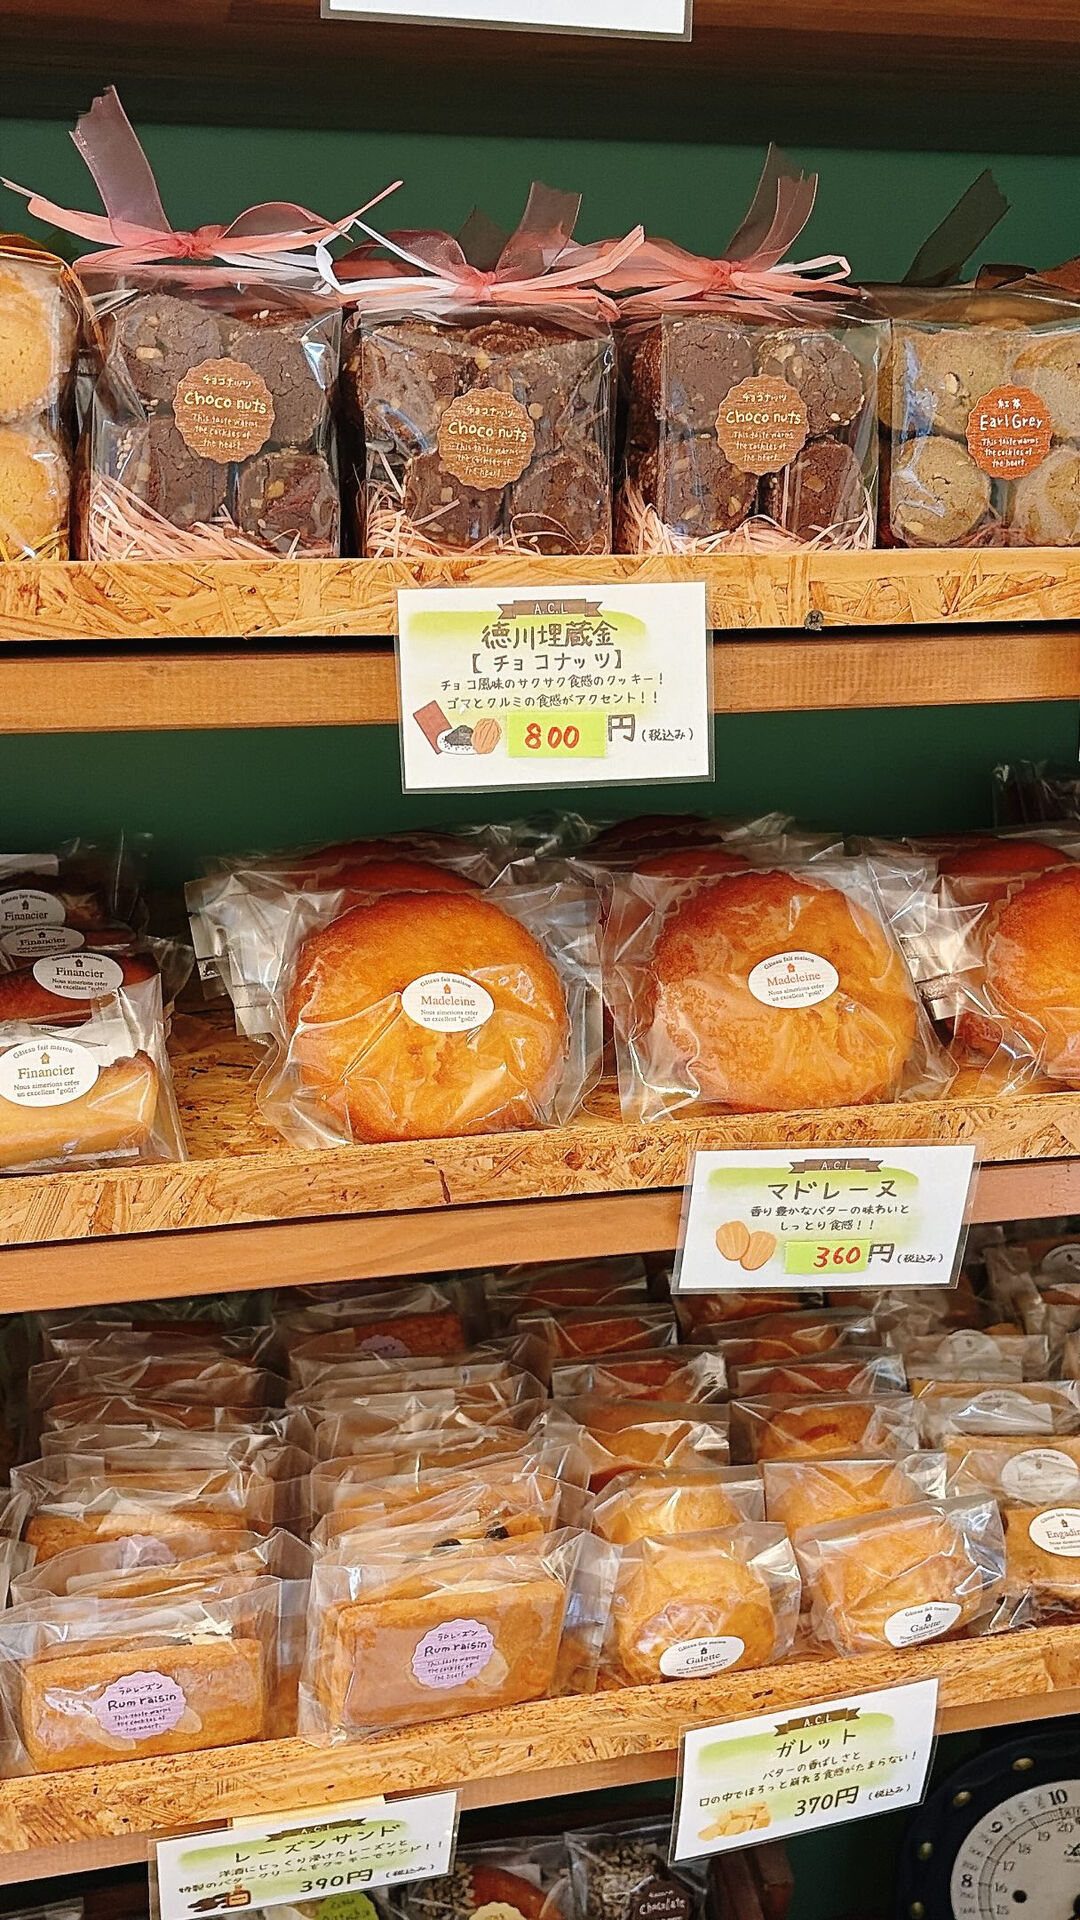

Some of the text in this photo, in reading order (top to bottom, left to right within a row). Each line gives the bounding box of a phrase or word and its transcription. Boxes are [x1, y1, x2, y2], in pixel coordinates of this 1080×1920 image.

[184, 391, 267, 414] Choco nuts
[726, 410, 801, 425] Choco nuts
[980, 413, 1043, 431] Earl Grey
[448, 419, 527, 442] Choco nuts
[481, 620, 618, 650] 徳川埋蔵金
[5, 911, 48, 921] Financier
[56, 967, 104, 978] Financier
[767, 972, 821, 987] Madeleine
[421, 995, 477, 1007] Madeleine
[18, 1065, 75, 1080] Financier
[767, 1179, 898, 1201] マドレーヌ
[750, 1203, 910, 1218] 香り豊かなバターの味わいと
[424, 1641, 487, 1657] Rum raisin
[686, 1653, 720, 1665] Galette
[119, 1683, 163, 1695] ラムレーズン
[108, 1694, 176, 1711] Rum raisin
[776, 1729, 856, 1759] ガレット
[763, 1751, 861, 1780] バターの香ばしさと
[794, 1786, 859, 1818] 370円
[1048, 1789, 1067, 1805] 10
[990, 1821, 1003, 1833] 9
[235, 1824, 400, 1863] レーズンサンド
[1003, 1861, 1015, 1871] 17
[300, 1869, 373, 1893] 390円
[961, 1874, 972, 1887] 8
